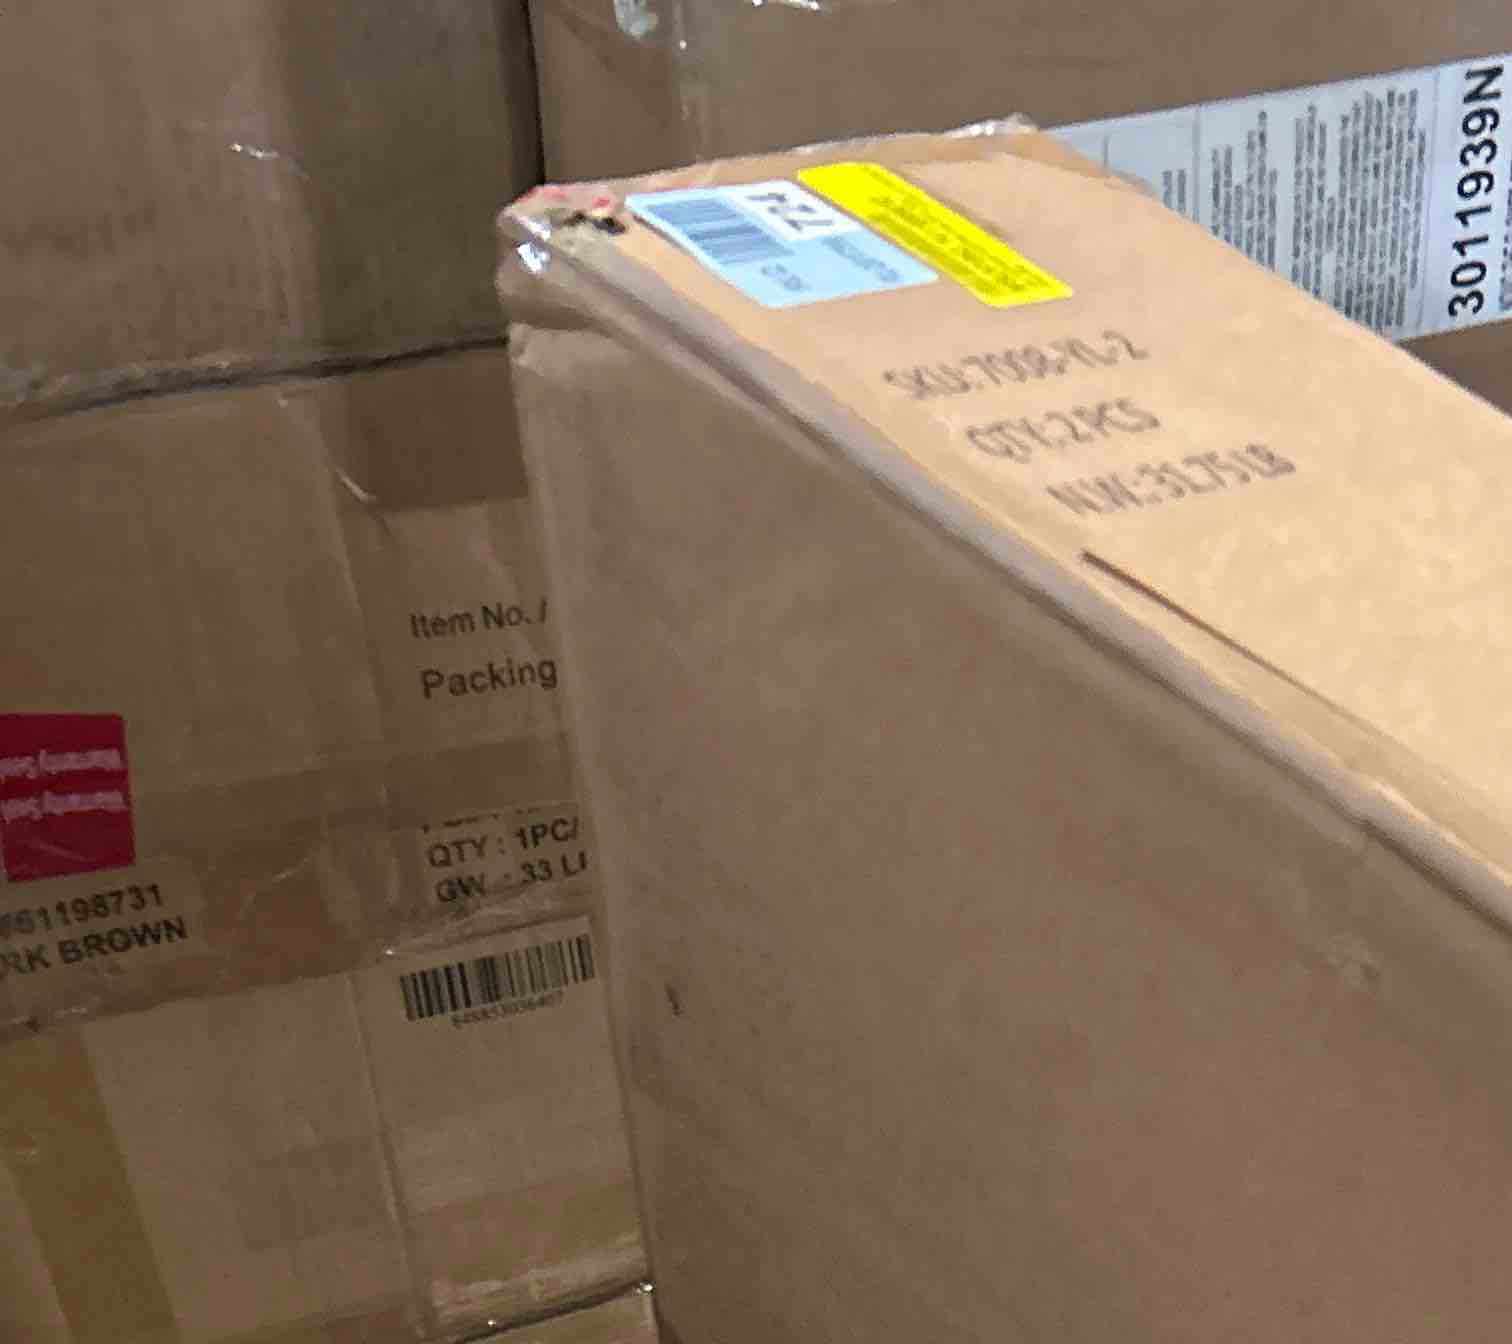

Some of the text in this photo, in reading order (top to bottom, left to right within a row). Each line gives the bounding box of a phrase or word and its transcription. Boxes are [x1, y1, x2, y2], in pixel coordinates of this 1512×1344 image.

[1449, 64, 1503, 317] 3011939N
[409, 612, 475, 640] Item
[481, 601, 531, 630] No.
[420, 657, 558, 699] Packing
[428, 835, 488, 868] QTY
[521, 858, 553, 884] 33
[0, 914, 188, 980] RK BROWN
